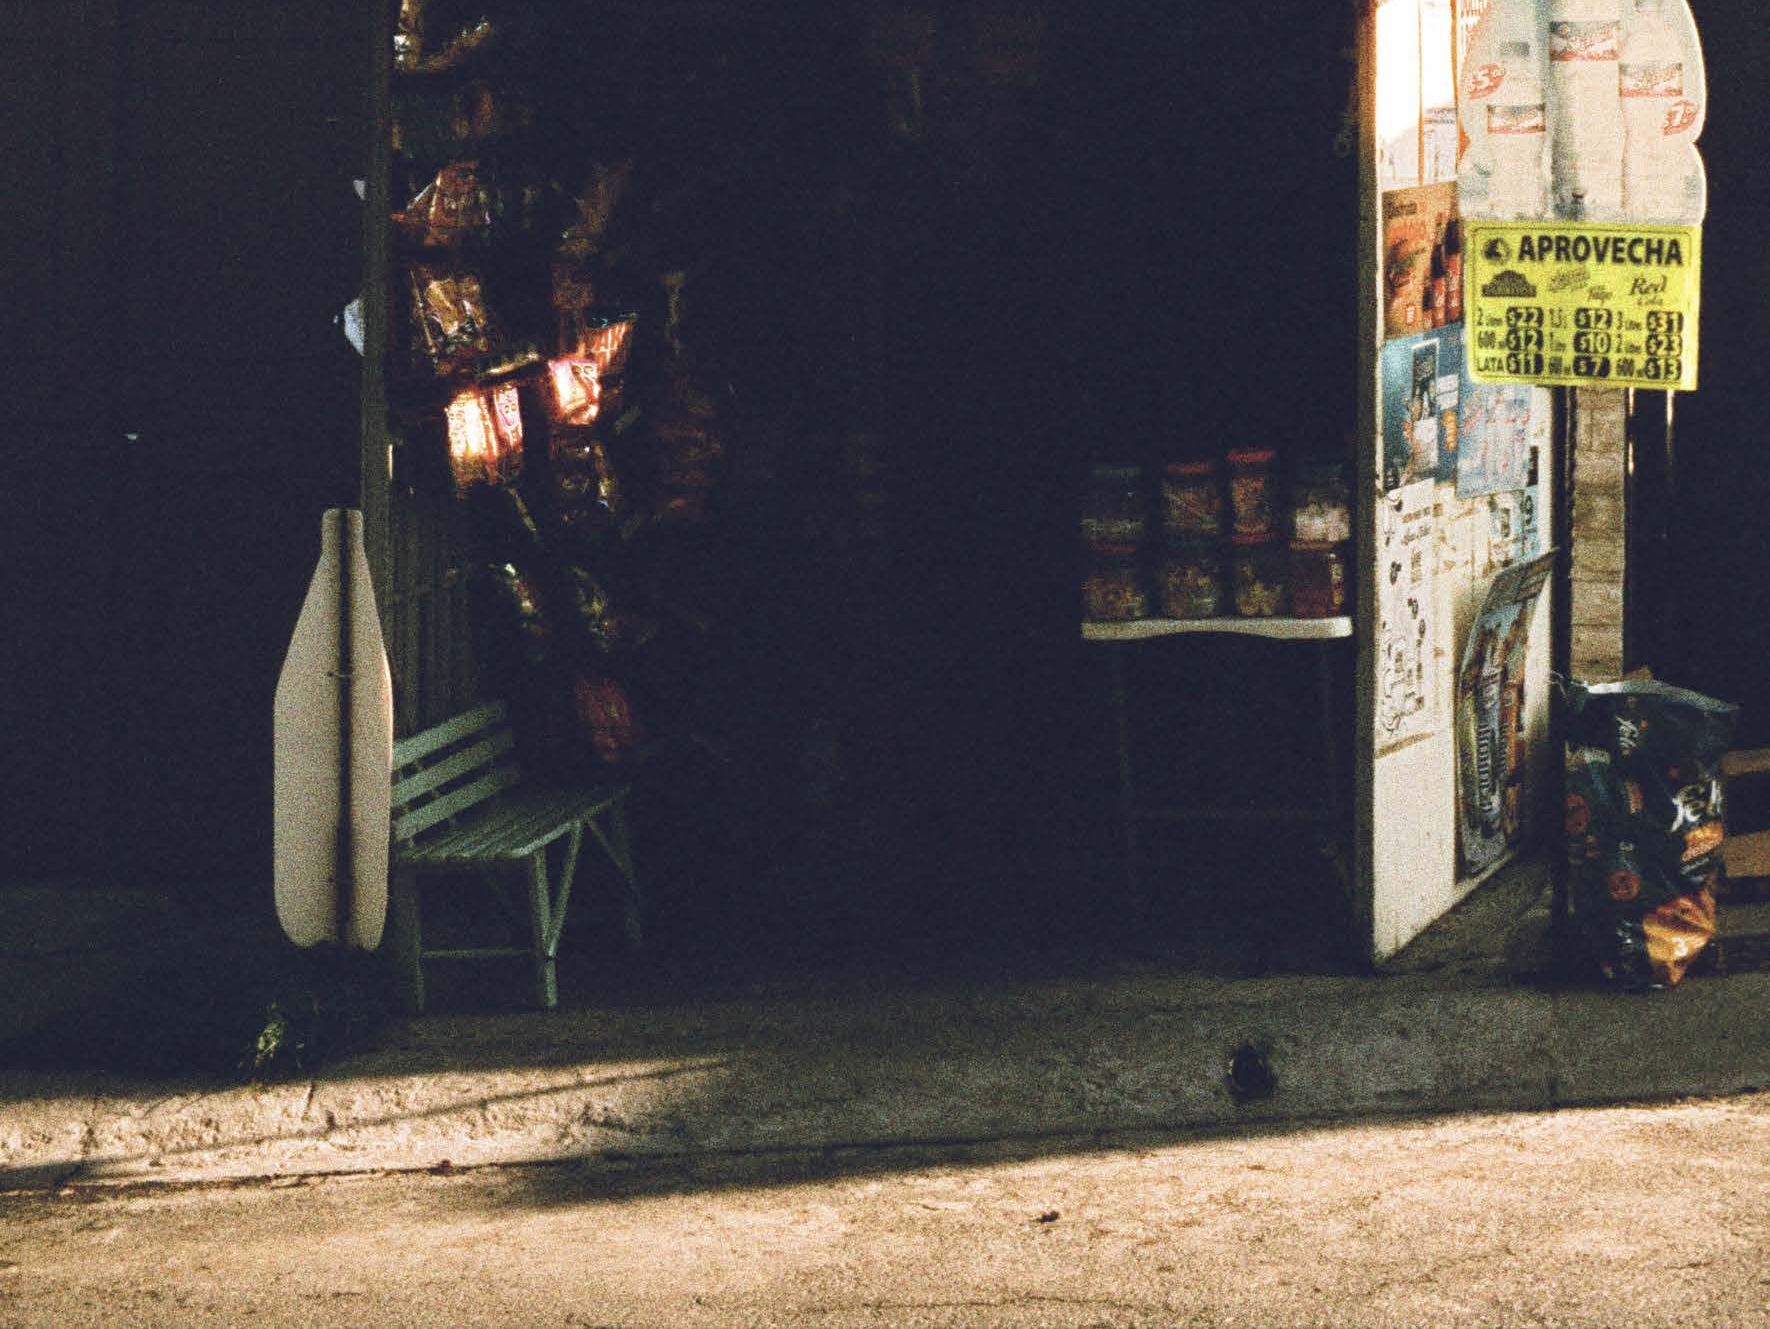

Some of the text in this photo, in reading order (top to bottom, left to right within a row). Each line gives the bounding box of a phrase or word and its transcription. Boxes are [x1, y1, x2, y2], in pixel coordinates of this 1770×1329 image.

[1518, 233, 1684, 267] APROVECHA
[1629, 274, 1667, 296] Red
[1508, 307, 1540, 327] $22
[1579, 309, 1609, 329] $12
[1508, 328, 1539, 351] $12
[1579, 332, 1608, 354] $10
[1477, 357, 1504, 372] LATA
